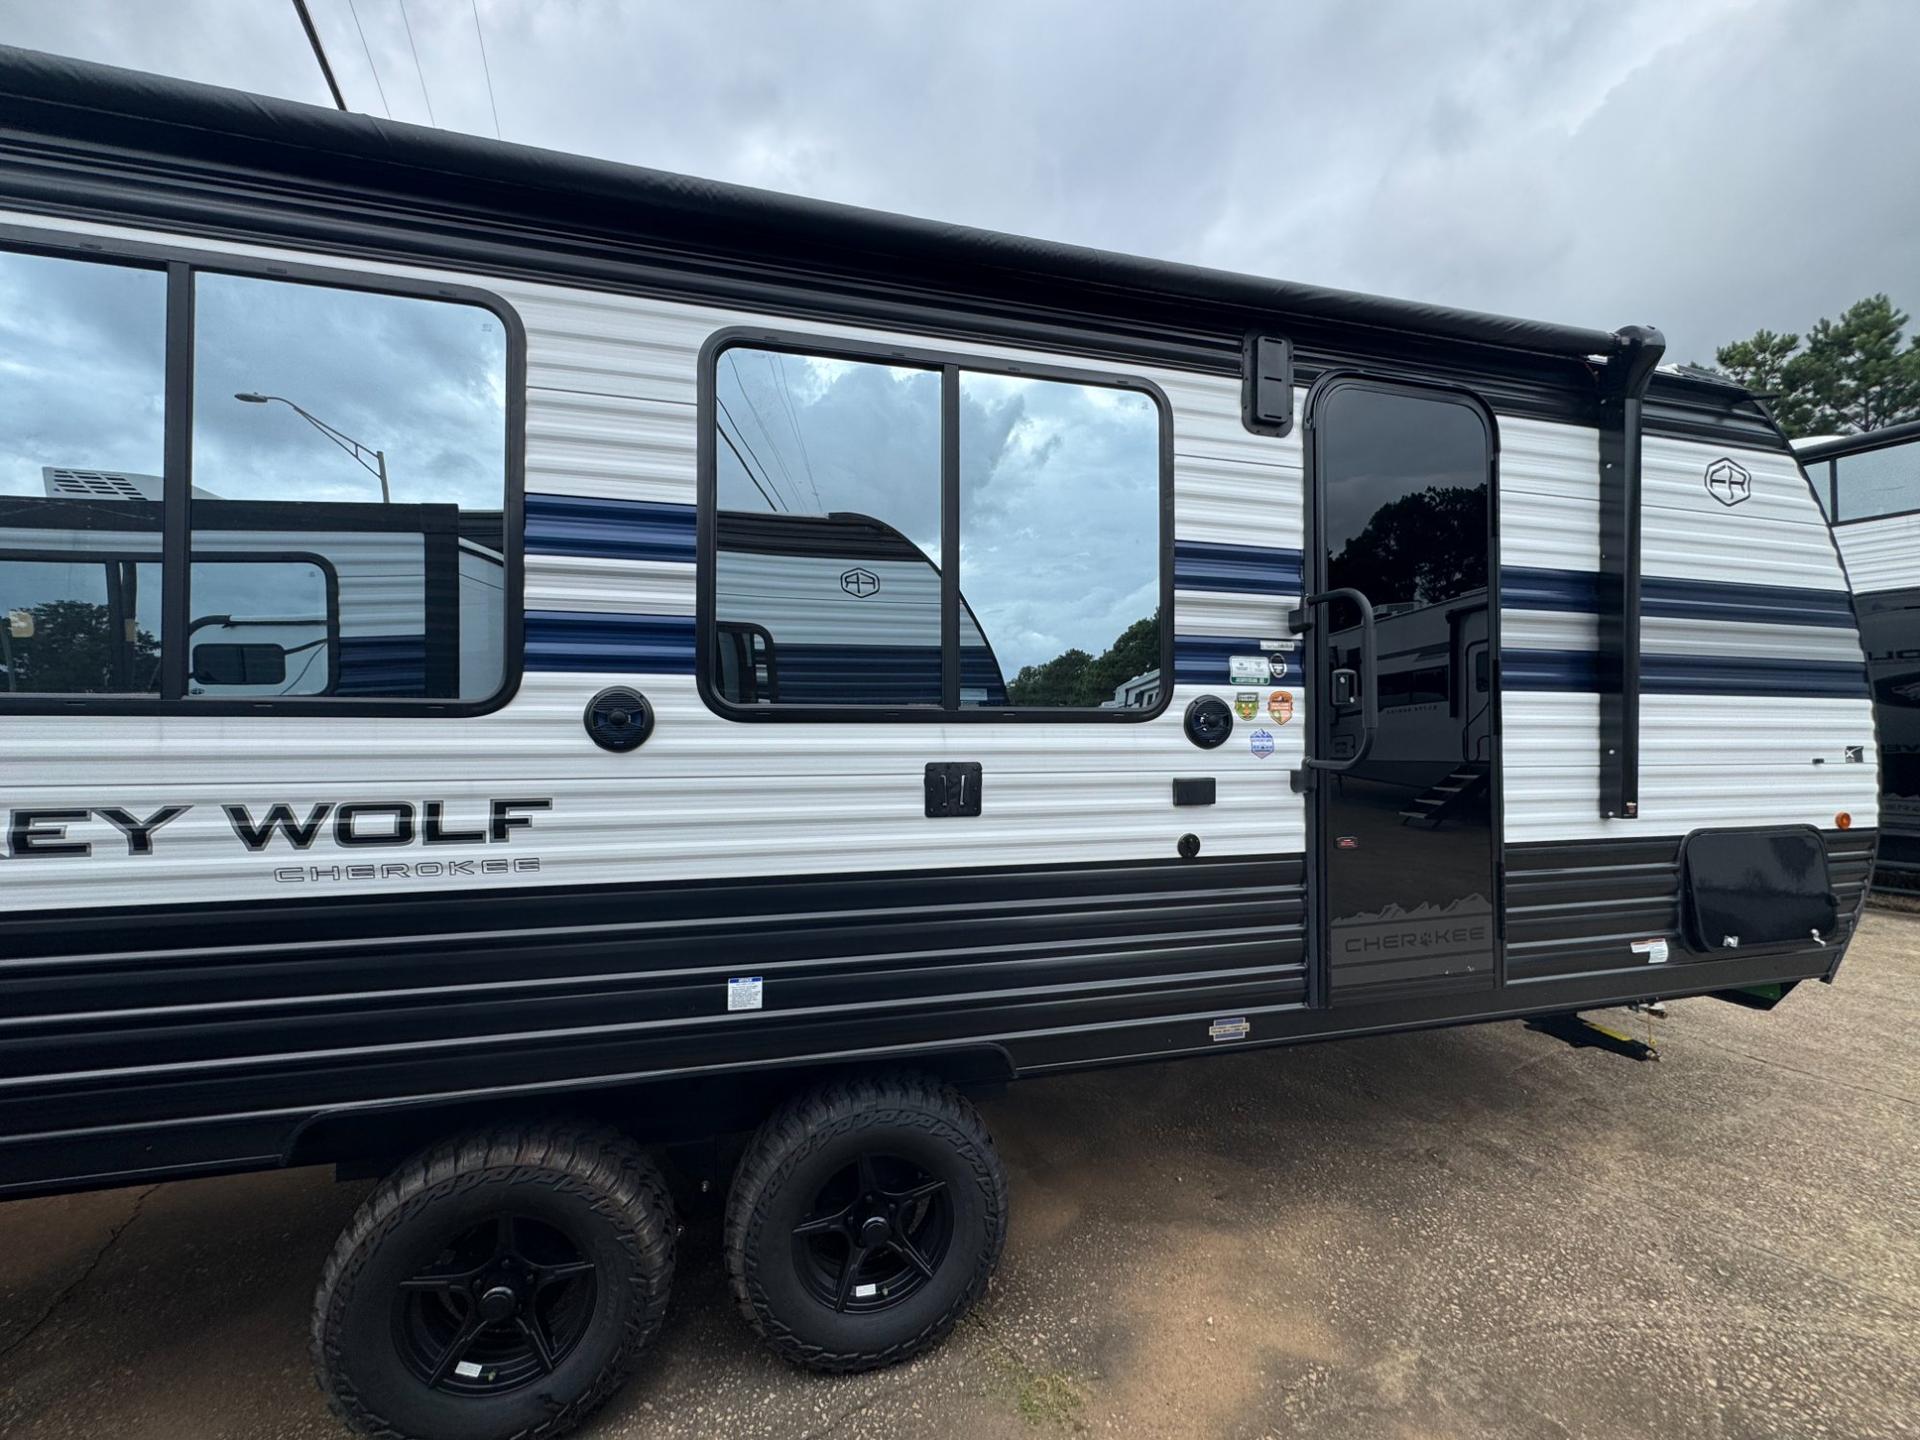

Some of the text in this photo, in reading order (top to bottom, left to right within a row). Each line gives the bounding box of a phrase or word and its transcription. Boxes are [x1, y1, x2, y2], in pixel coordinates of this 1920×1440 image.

[0, 797, 553, 858] EY WOLF
[274, 857, 540, 883] CHEROKEE
